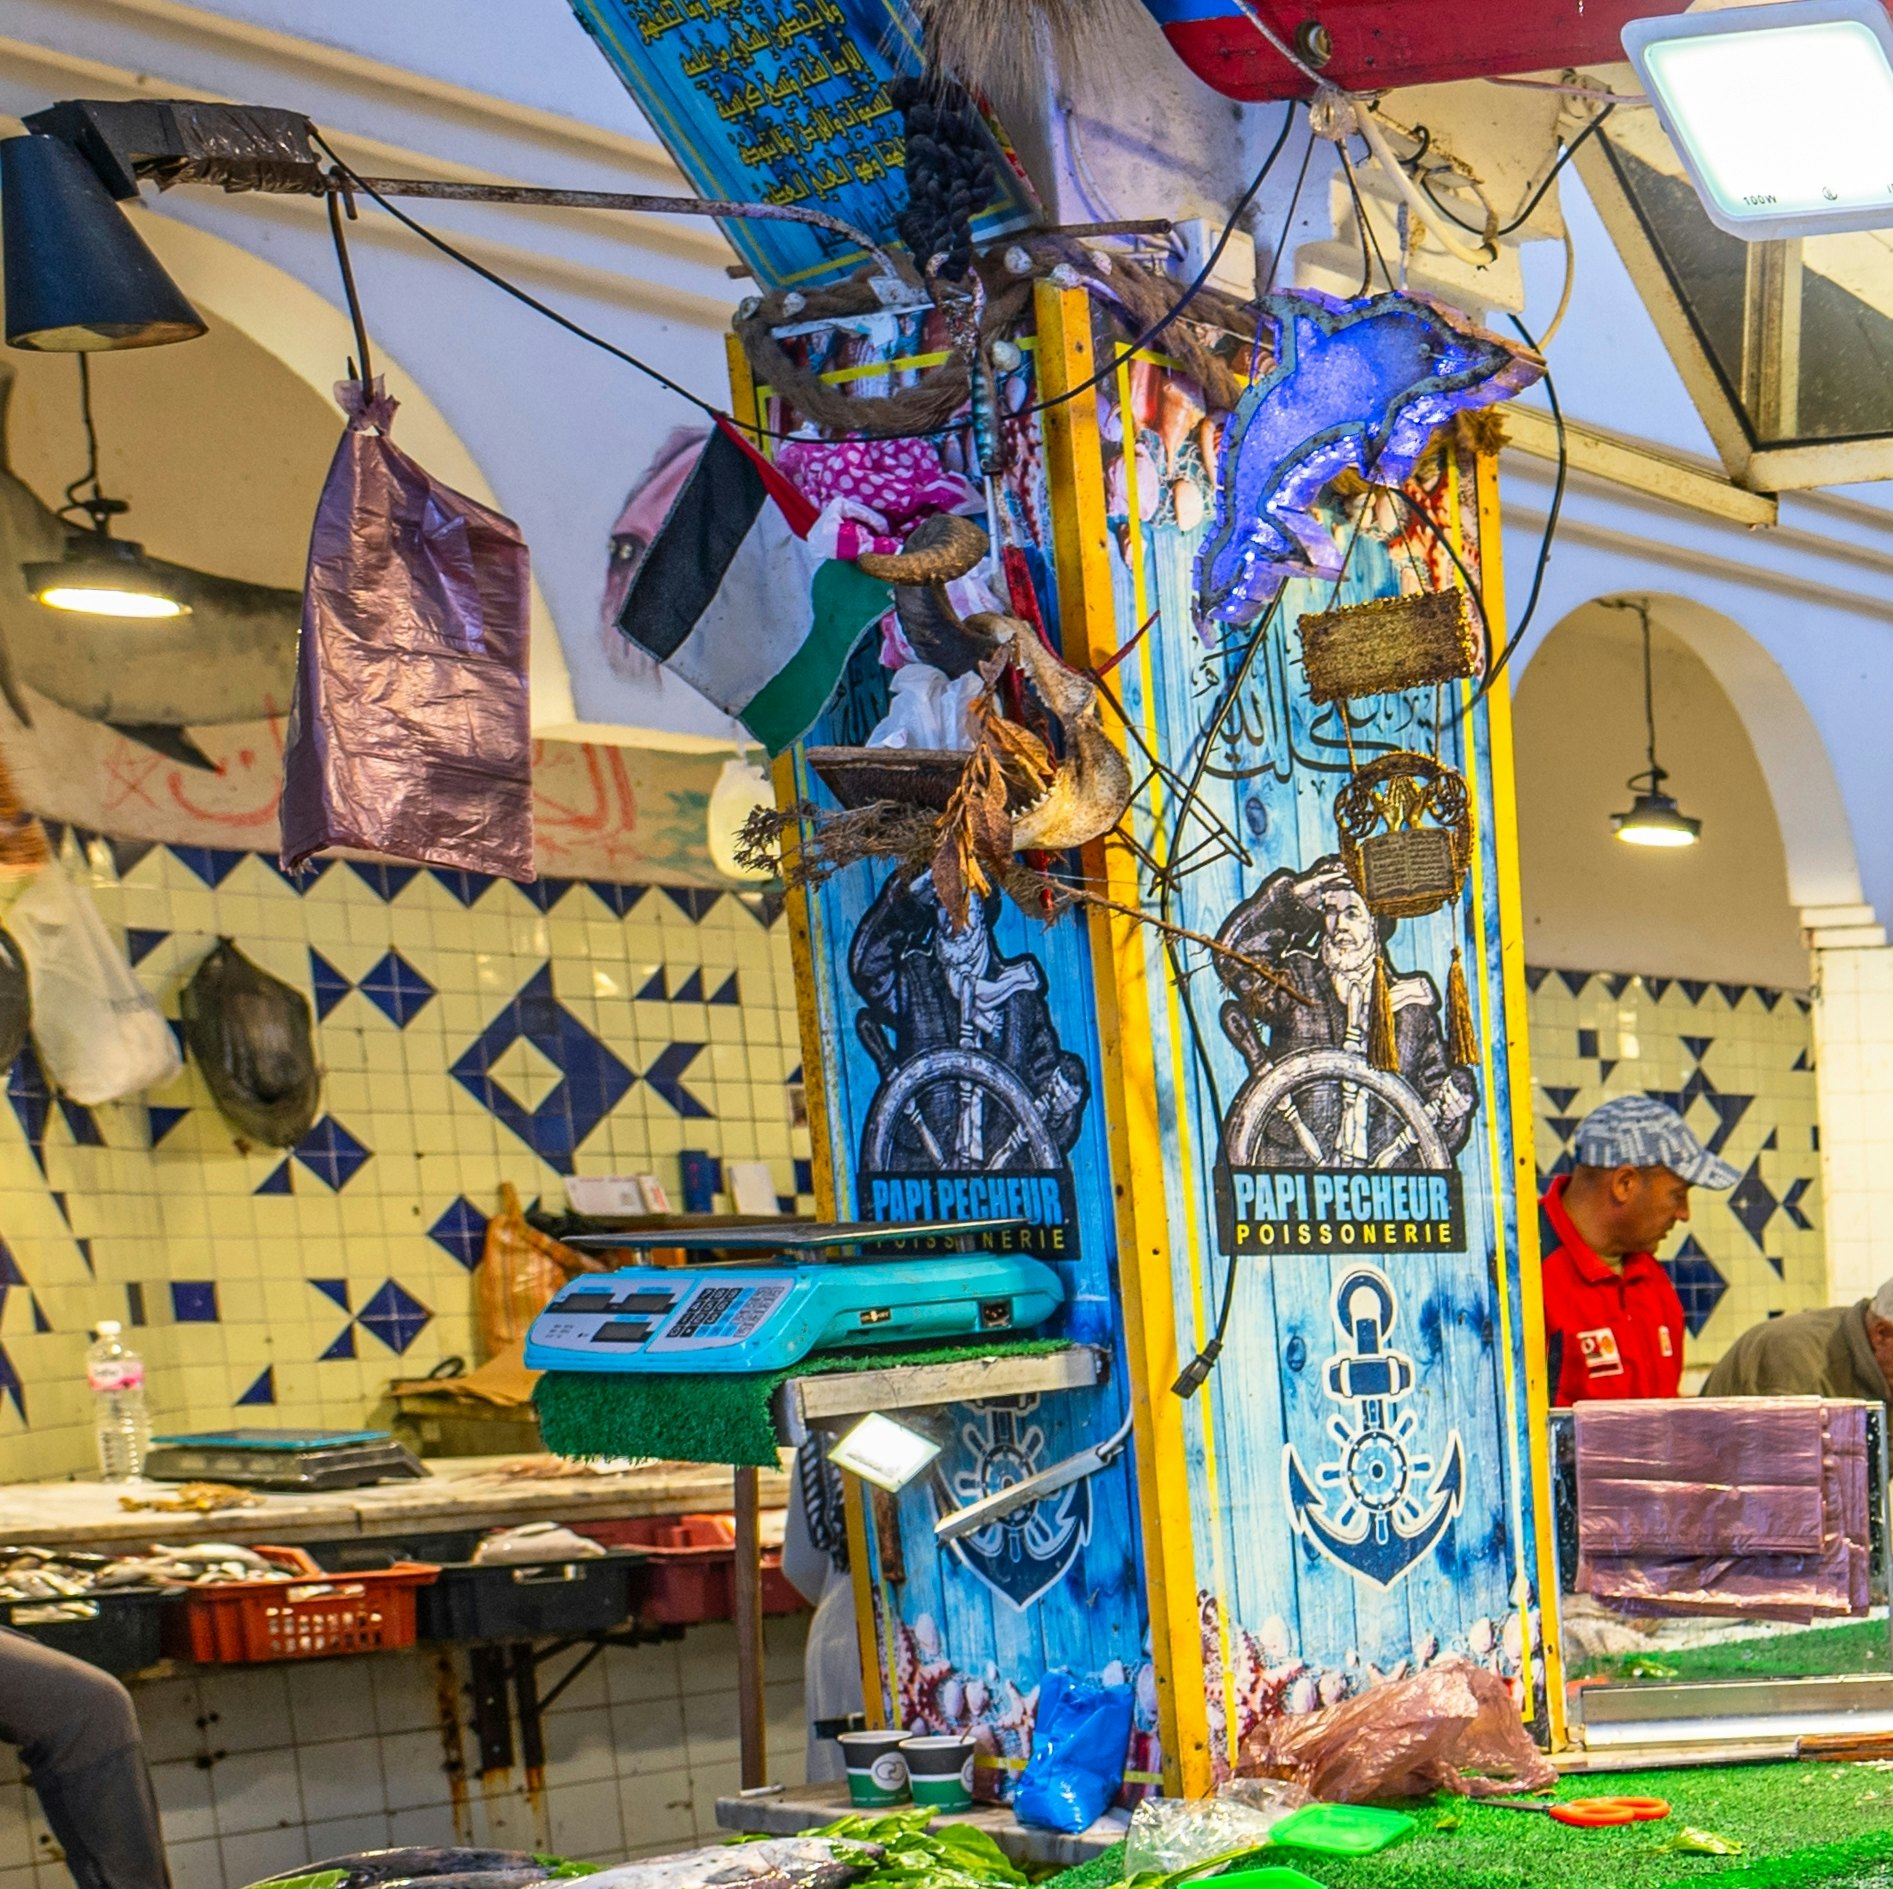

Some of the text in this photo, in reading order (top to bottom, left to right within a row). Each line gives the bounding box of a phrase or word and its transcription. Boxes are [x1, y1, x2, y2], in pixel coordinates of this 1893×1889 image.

[1744, 194, 1777, 207] 100W
[872, 1177, 1065, 1226] PAPI PECHEUR
[1233, 1174, 1450, 1222] PAPI PECHEUR
[1236, 1224, 1452, 1245] POISSONERIE
